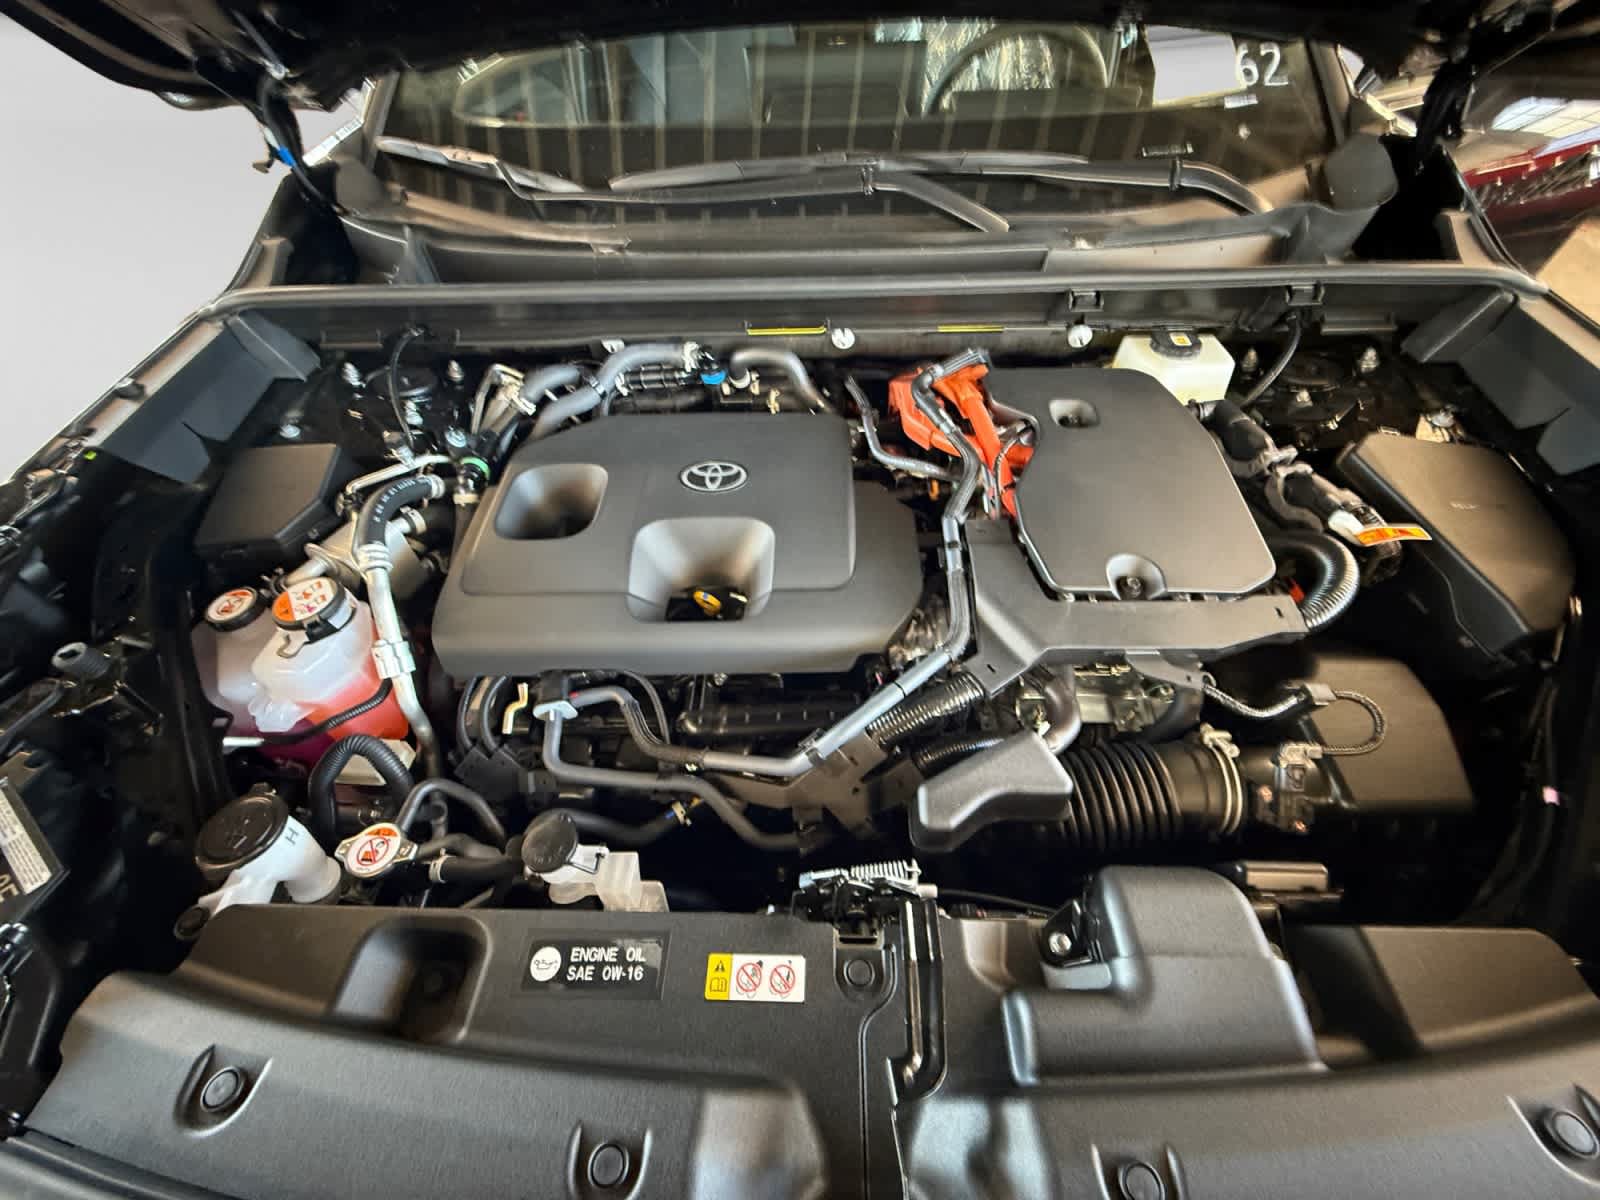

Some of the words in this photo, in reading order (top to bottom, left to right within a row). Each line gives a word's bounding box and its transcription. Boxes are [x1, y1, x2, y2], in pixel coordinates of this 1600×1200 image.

[1237, 41, 1289, 87] 62
[570, 946, 619, 962] ENGINE
[625, 946, 647, 962] OIL
[566, 965, 595, 981] SAE
[602, 964, 644, 981] 0W-16
